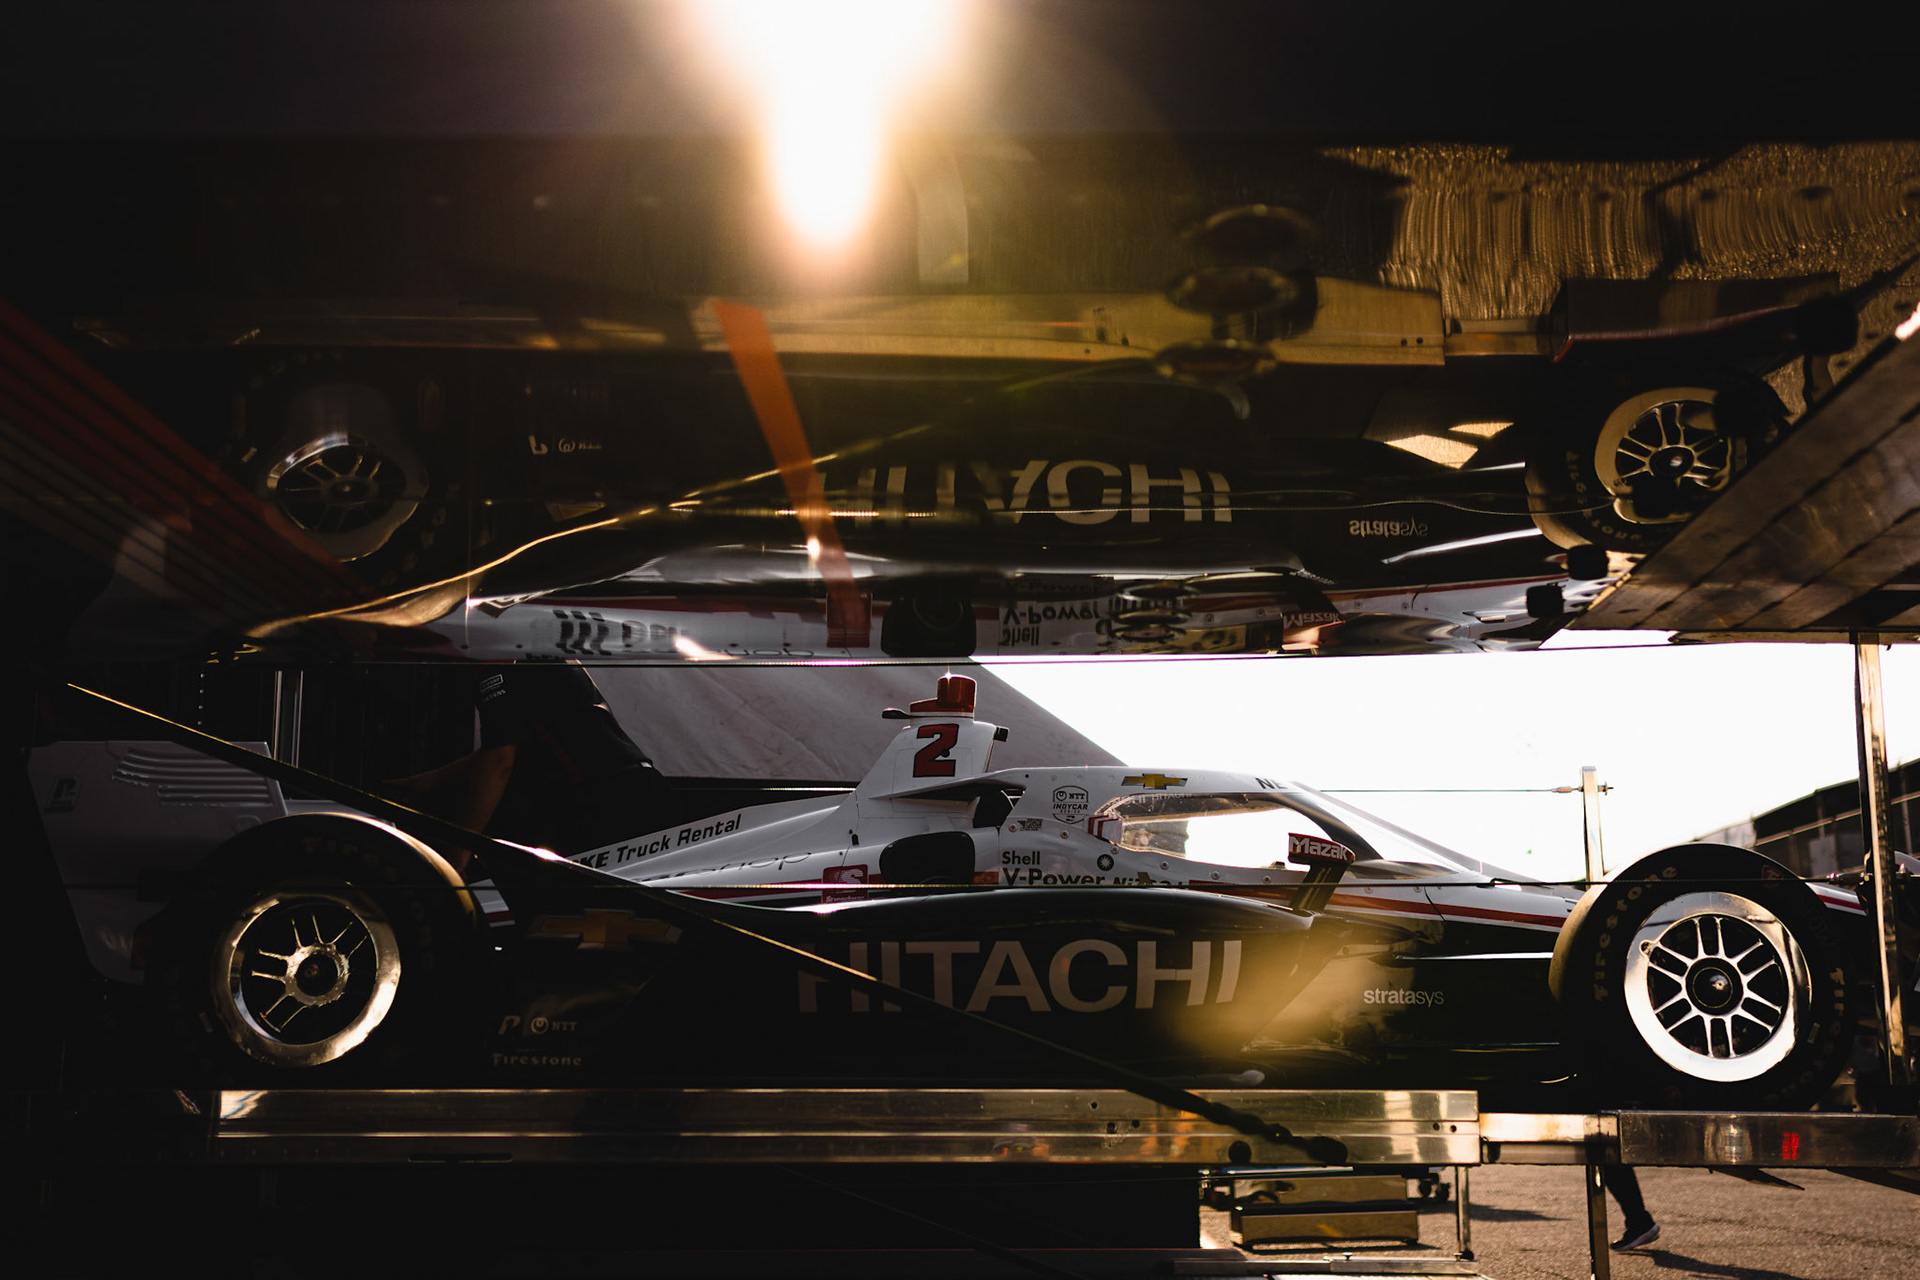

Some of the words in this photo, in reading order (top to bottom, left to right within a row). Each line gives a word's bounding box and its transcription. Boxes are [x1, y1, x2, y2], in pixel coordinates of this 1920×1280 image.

[912, 723, 960, 778] 2
[1069, 792, 1086, 800] NTT
[1052, 803, 1089, 811] INDYCAR
[616, 835, 670, 864] Truck
[677, 813, 743, 846] Rental
[1288, 835, 1349, 861] Mazak
[1002, 851, 1041, 866] Shell
[1002, 867, 1106, 887] V-Power
[797, 939, 1243, 1014] HITACHI
[1363, 987, 1445, 1008] stratasys
[551, 1020, 578, 1032] NTT
[490, 1052, 582, 1067] Firestone
